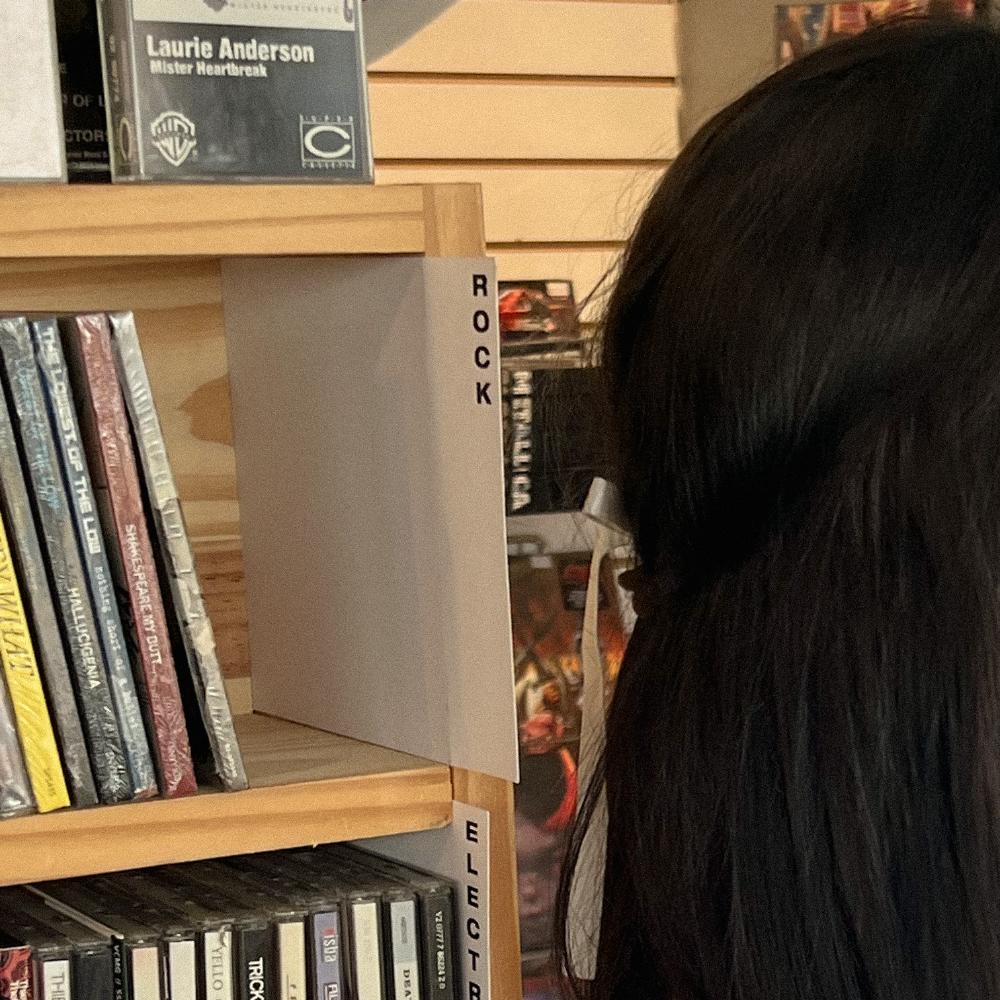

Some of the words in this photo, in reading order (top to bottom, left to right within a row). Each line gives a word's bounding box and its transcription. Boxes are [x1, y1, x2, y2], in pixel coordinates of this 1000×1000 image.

[146, 35, 213, 59] Laurie
[219, 37, 315, 63] Anderson
[150, 60, 194, 75] Mister
[196, 61, 268, 77] Heartbreak
[472, 273, 492, 405] ROCK
[67, 446, 83, 473] OF
[74, 475, 92, 514] THE
[83, 517, 101, 554] LOW
[124, 523, 152, 612] SHAKESPEARE
[143, 612, 157, 634] MY
[66, 586, 102, 690] HALLUCIGENIA
[211, 945, 225, 991] YELLO
